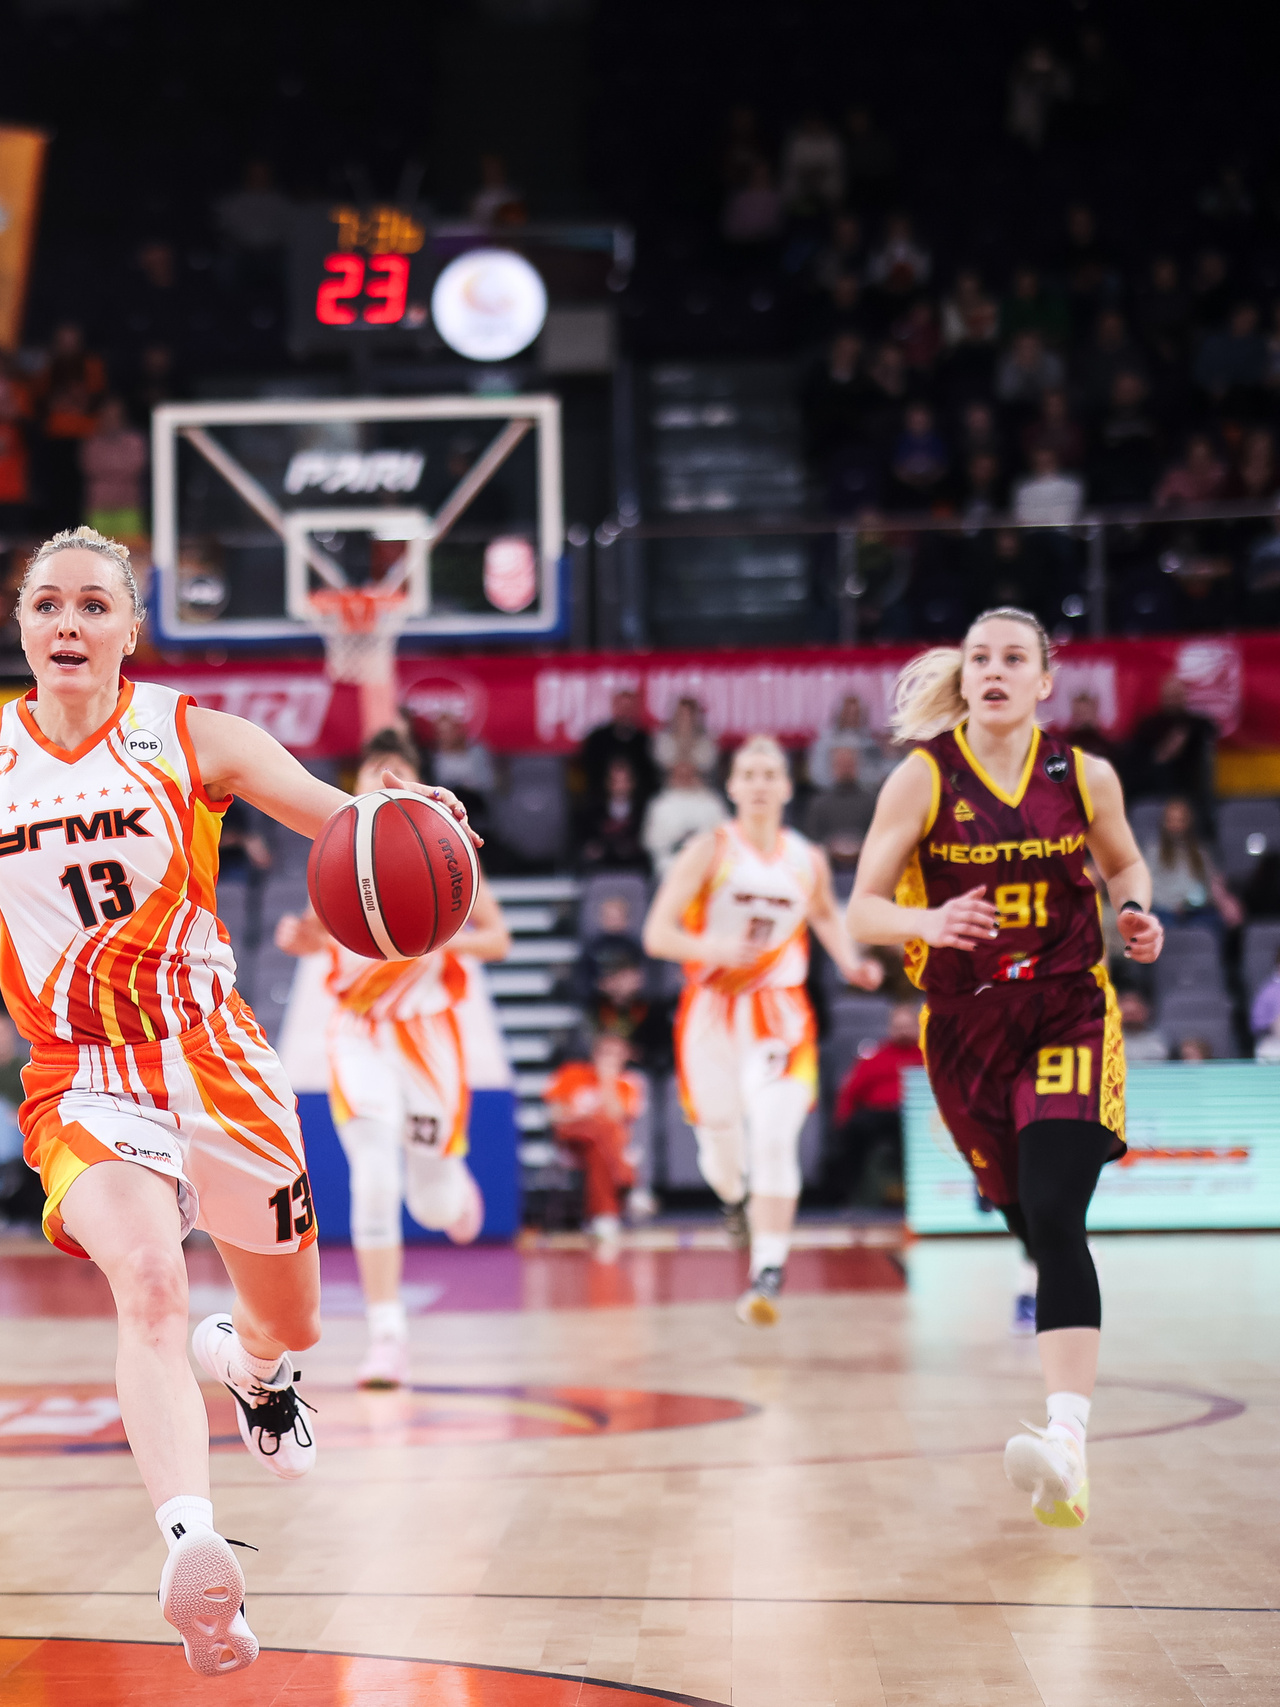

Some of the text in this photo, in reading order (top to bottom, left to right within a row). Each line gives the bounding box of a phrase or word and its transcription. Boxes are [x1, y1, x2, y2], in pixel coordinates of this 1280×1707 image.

[316, 252, 410, 325] 23
[129, 740, 158, 751] РФБ
[58, 859, 137, 931] 13
[361, 878, 376, 911] BG4000
[438, 838, 463, 912] molten
[995, 881, 1049, 928] 91
[1035, 1047, 1092, 1096] 91
[268, 1171, 316, 1243] 13
